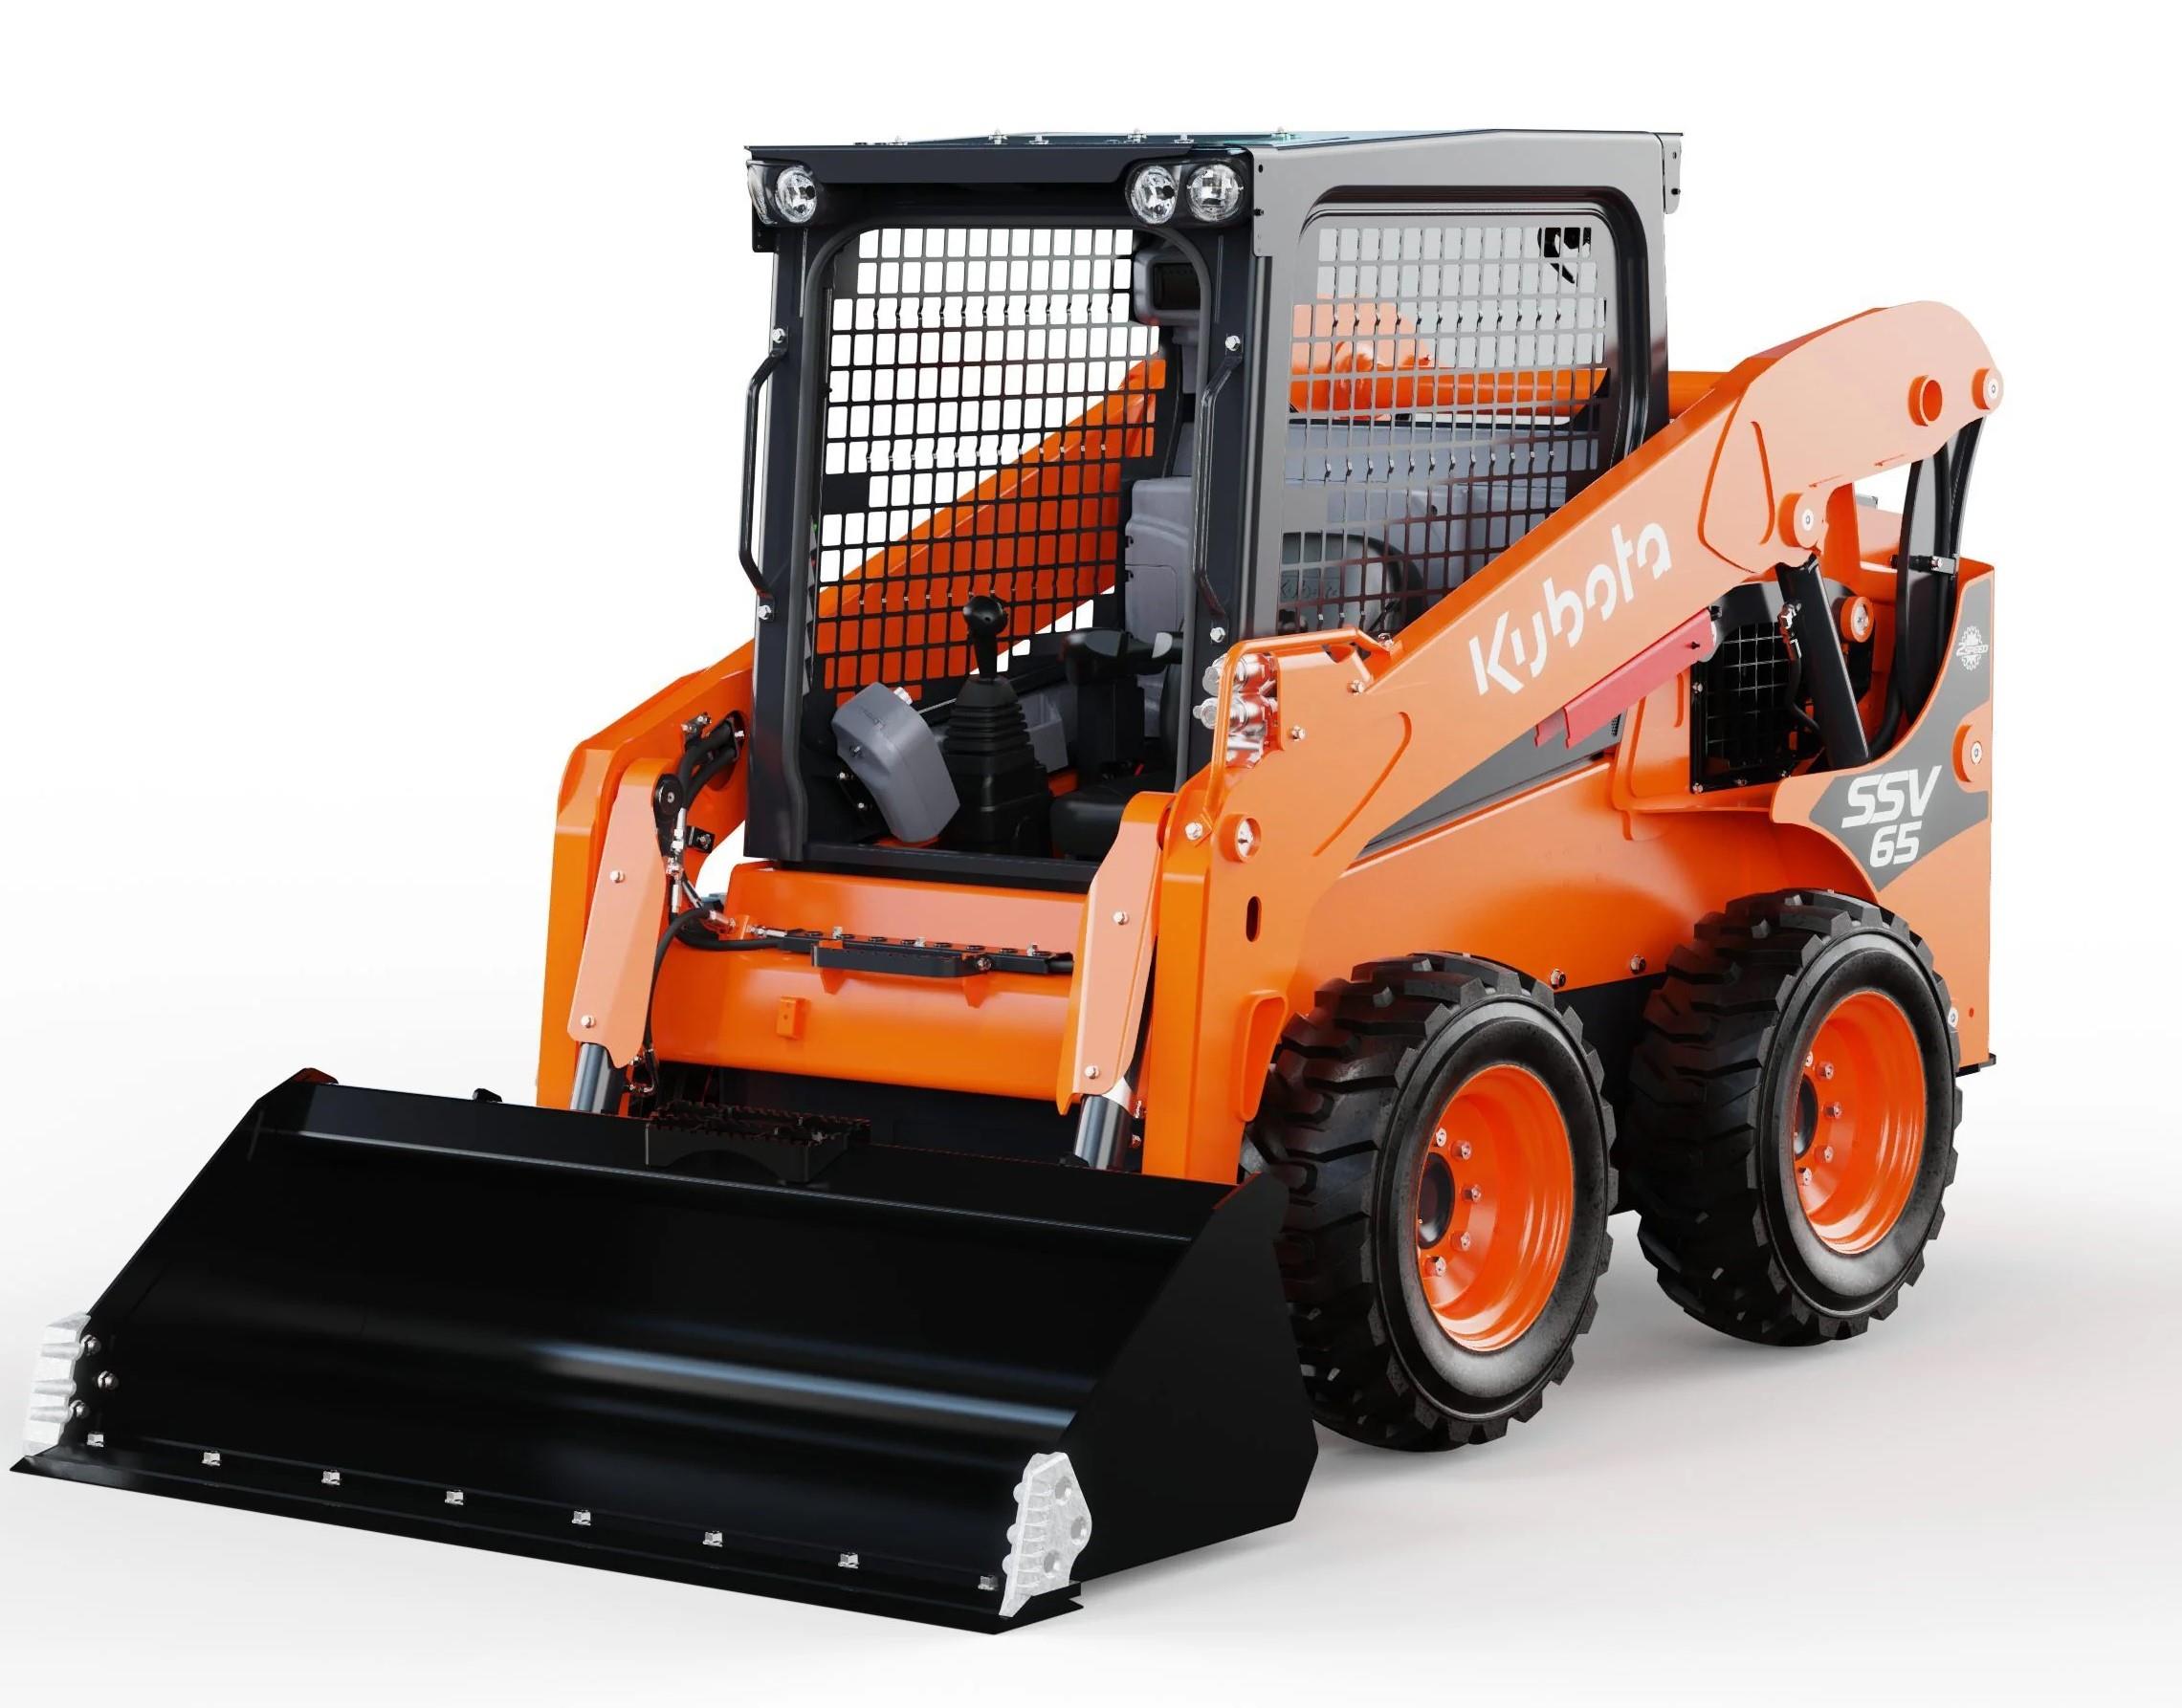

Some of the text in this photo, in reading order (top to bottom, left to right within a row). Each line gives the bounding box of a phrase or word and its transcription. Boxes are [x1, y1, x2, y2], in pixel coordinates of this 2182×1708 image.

[1468, 522, 1672, 696] Kubota
[1840, 765, 1942, 829] SSV
[1869, 821, 1923, 867] 65
